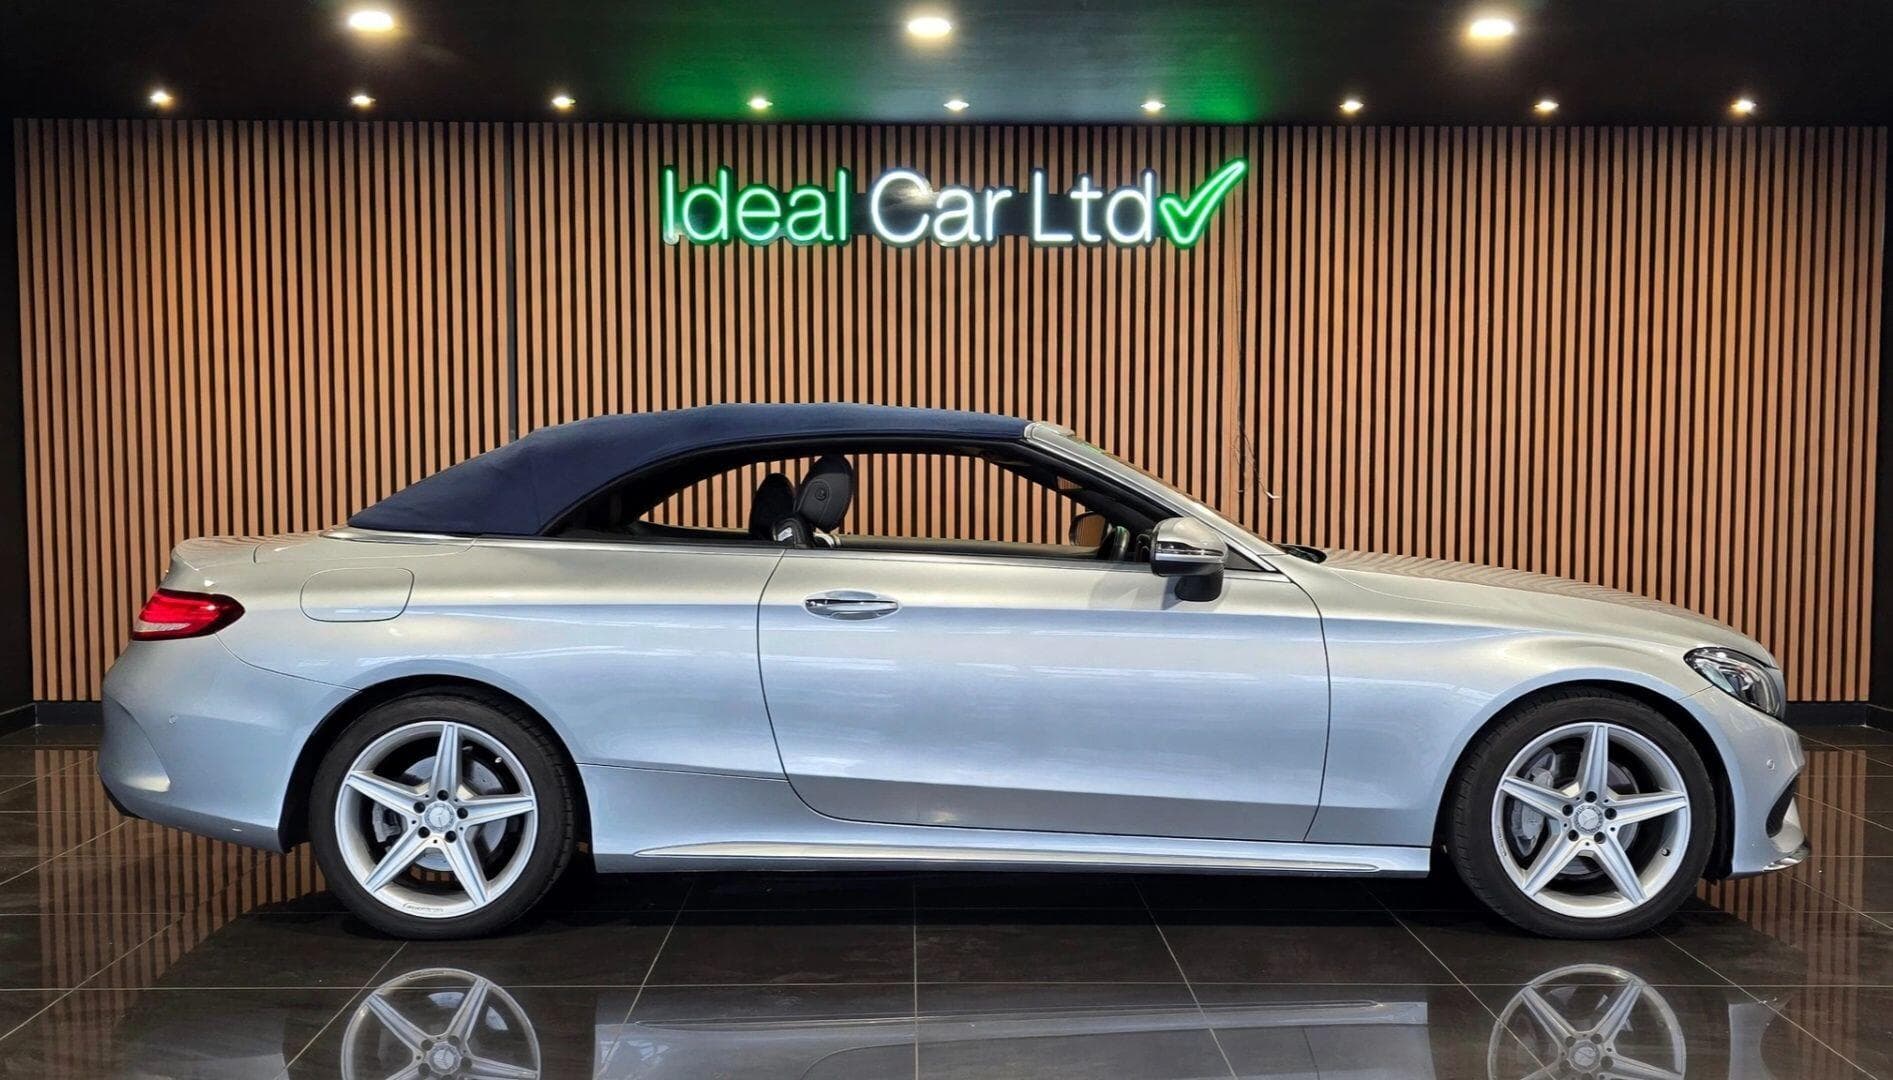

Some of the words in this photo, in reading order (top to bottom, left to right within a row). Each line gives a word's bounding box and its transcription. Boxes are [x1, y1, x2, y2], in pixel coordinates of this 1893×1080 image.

[664, 168, 848, 243] Ideal
[870, 169, 1013, 244] Car
[1033, 170, 1154, 244] Ltd
